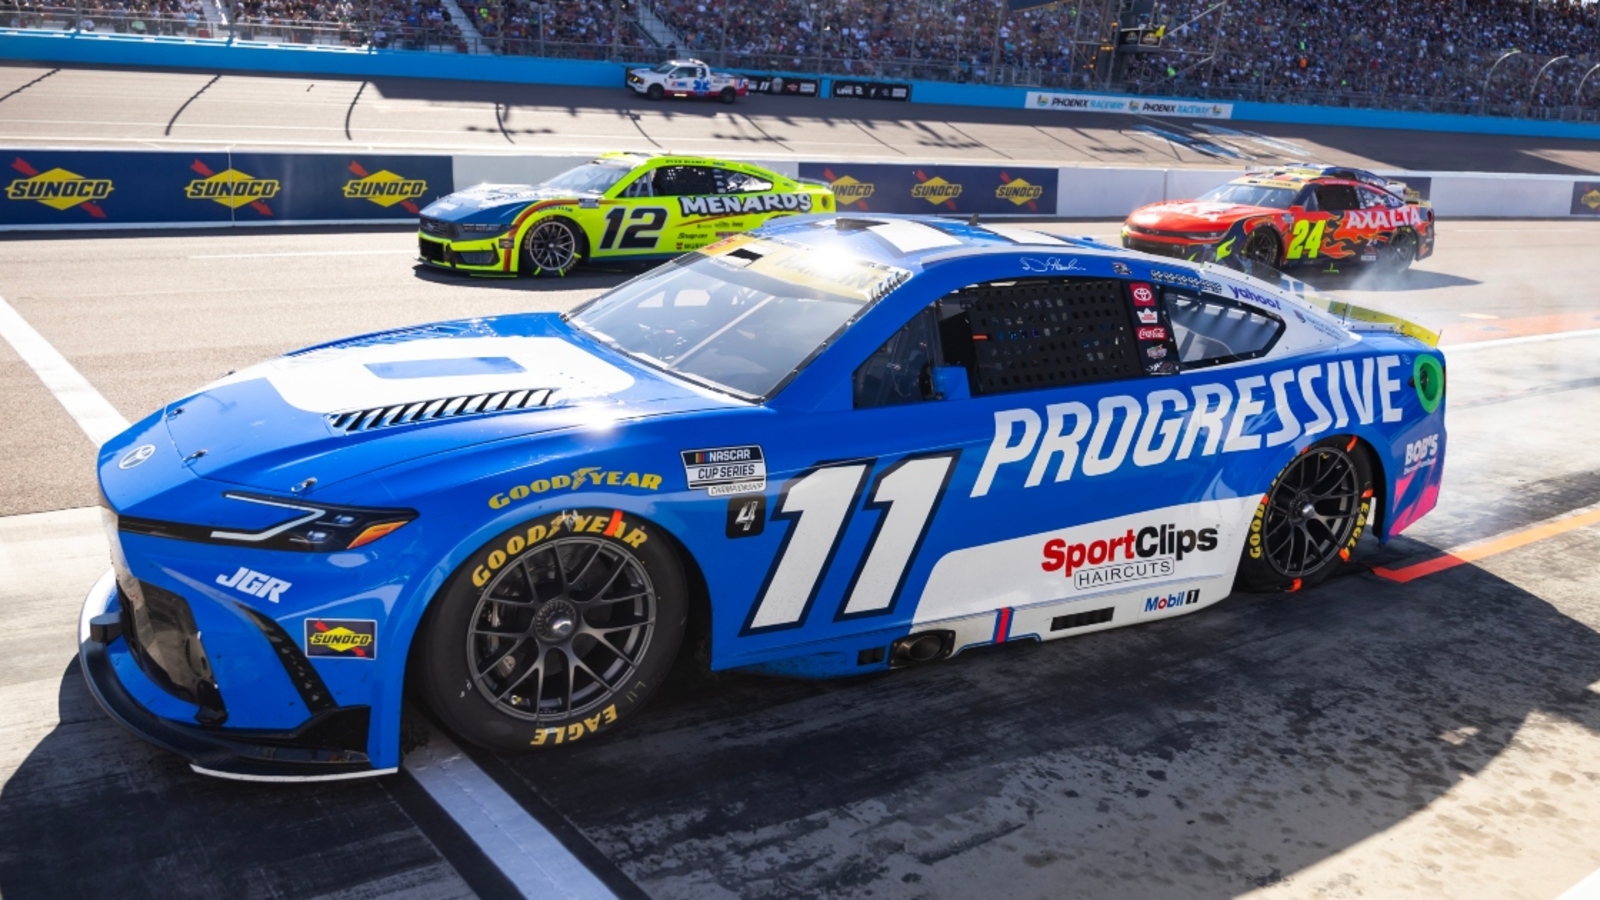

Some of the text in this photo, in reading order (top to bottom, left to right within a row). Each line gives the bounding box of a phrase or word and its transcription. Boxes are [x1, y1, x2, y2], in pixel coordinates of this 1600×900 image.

[1052, 97, 1124, 110] PHOENIX RACEWAY
[1142, 103, 1210, 115] PHOENIX RACEWAY
[11, 180, 111, 199] SUNOCO
[189, 181, 276, 198] SUNOCO
[346, 181, 425, 198] SUNOCO
[832, 185, 872, 197] UNOCO
[914, 185, 960, 198] SUNOCO
[997, 186, 1042, 198] SUNOCO
[679, 193, 813, 216] MENARDS
[1346, 203, 1422, 229] AXALTA
[600, 207, 669, 250] 12
[1286, 219, 1326, 259] 24
[970, 355, 1404, 498] PROGRESSIVE
[709, 449, 751, 462] NASCAR
[1404, 433, 1439, 466] BOB'S
[698, 464, 755, 480] CUP SERIES
[710, 482, 764, 495] CHAMPIONSHIP
[734, 501, 760, 532] 4
[737, 448, 963, 638] 11
[1078, 560, 1171, 587] HAIRCUTS
[215, 566, 293, 604] JGR
[1143, 588, 1201, 613] Mobil 1
[312, 633, 373, 647] SUNOCO
[529, 703, 619, 746] EAGLE
